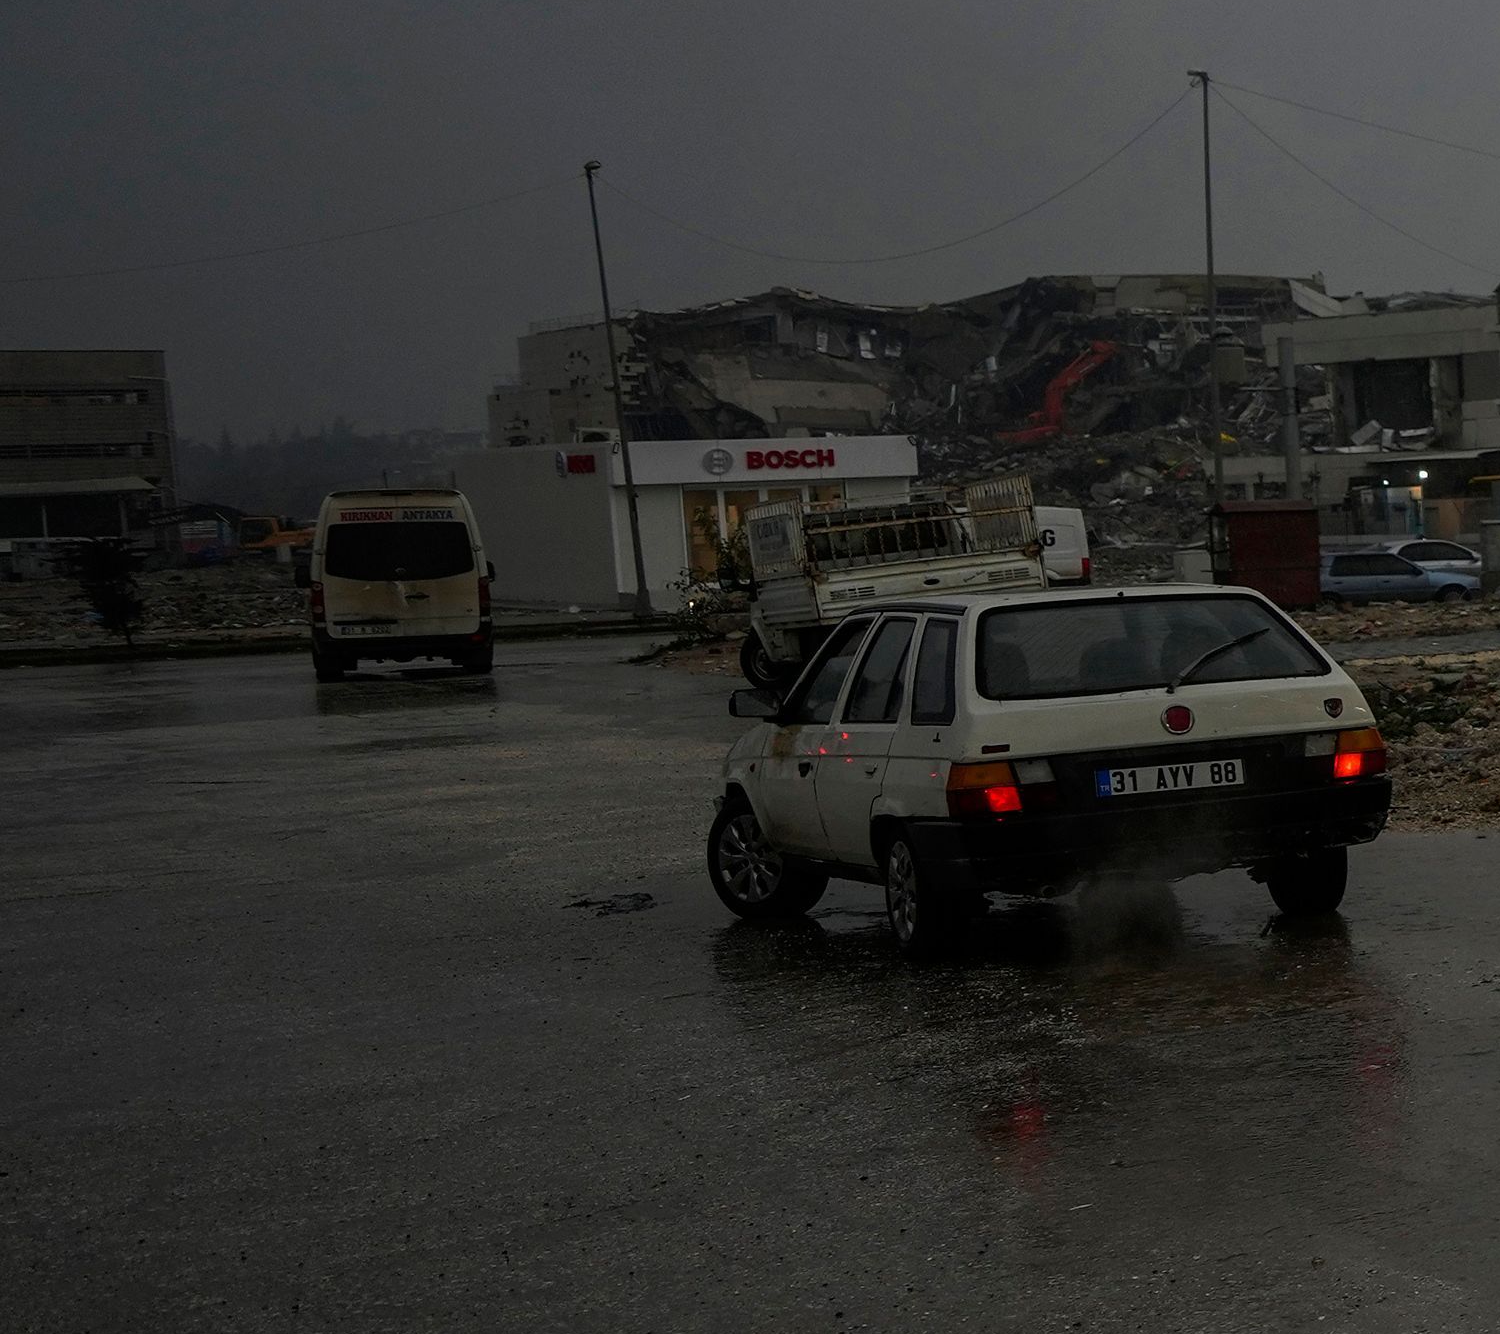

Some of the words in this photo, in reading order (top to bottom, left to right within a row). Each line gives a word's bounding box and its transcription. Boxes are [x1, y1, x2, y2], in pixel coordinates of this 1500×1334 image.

[746, 449, 835, 470] BOSCH
[402, 510, 454, 521] ANTAKYA
[1111, 771, 1138, 793] 31
[1156, 765, 1194, 790] AYV
[1210, 761, 1237, 784] 88
